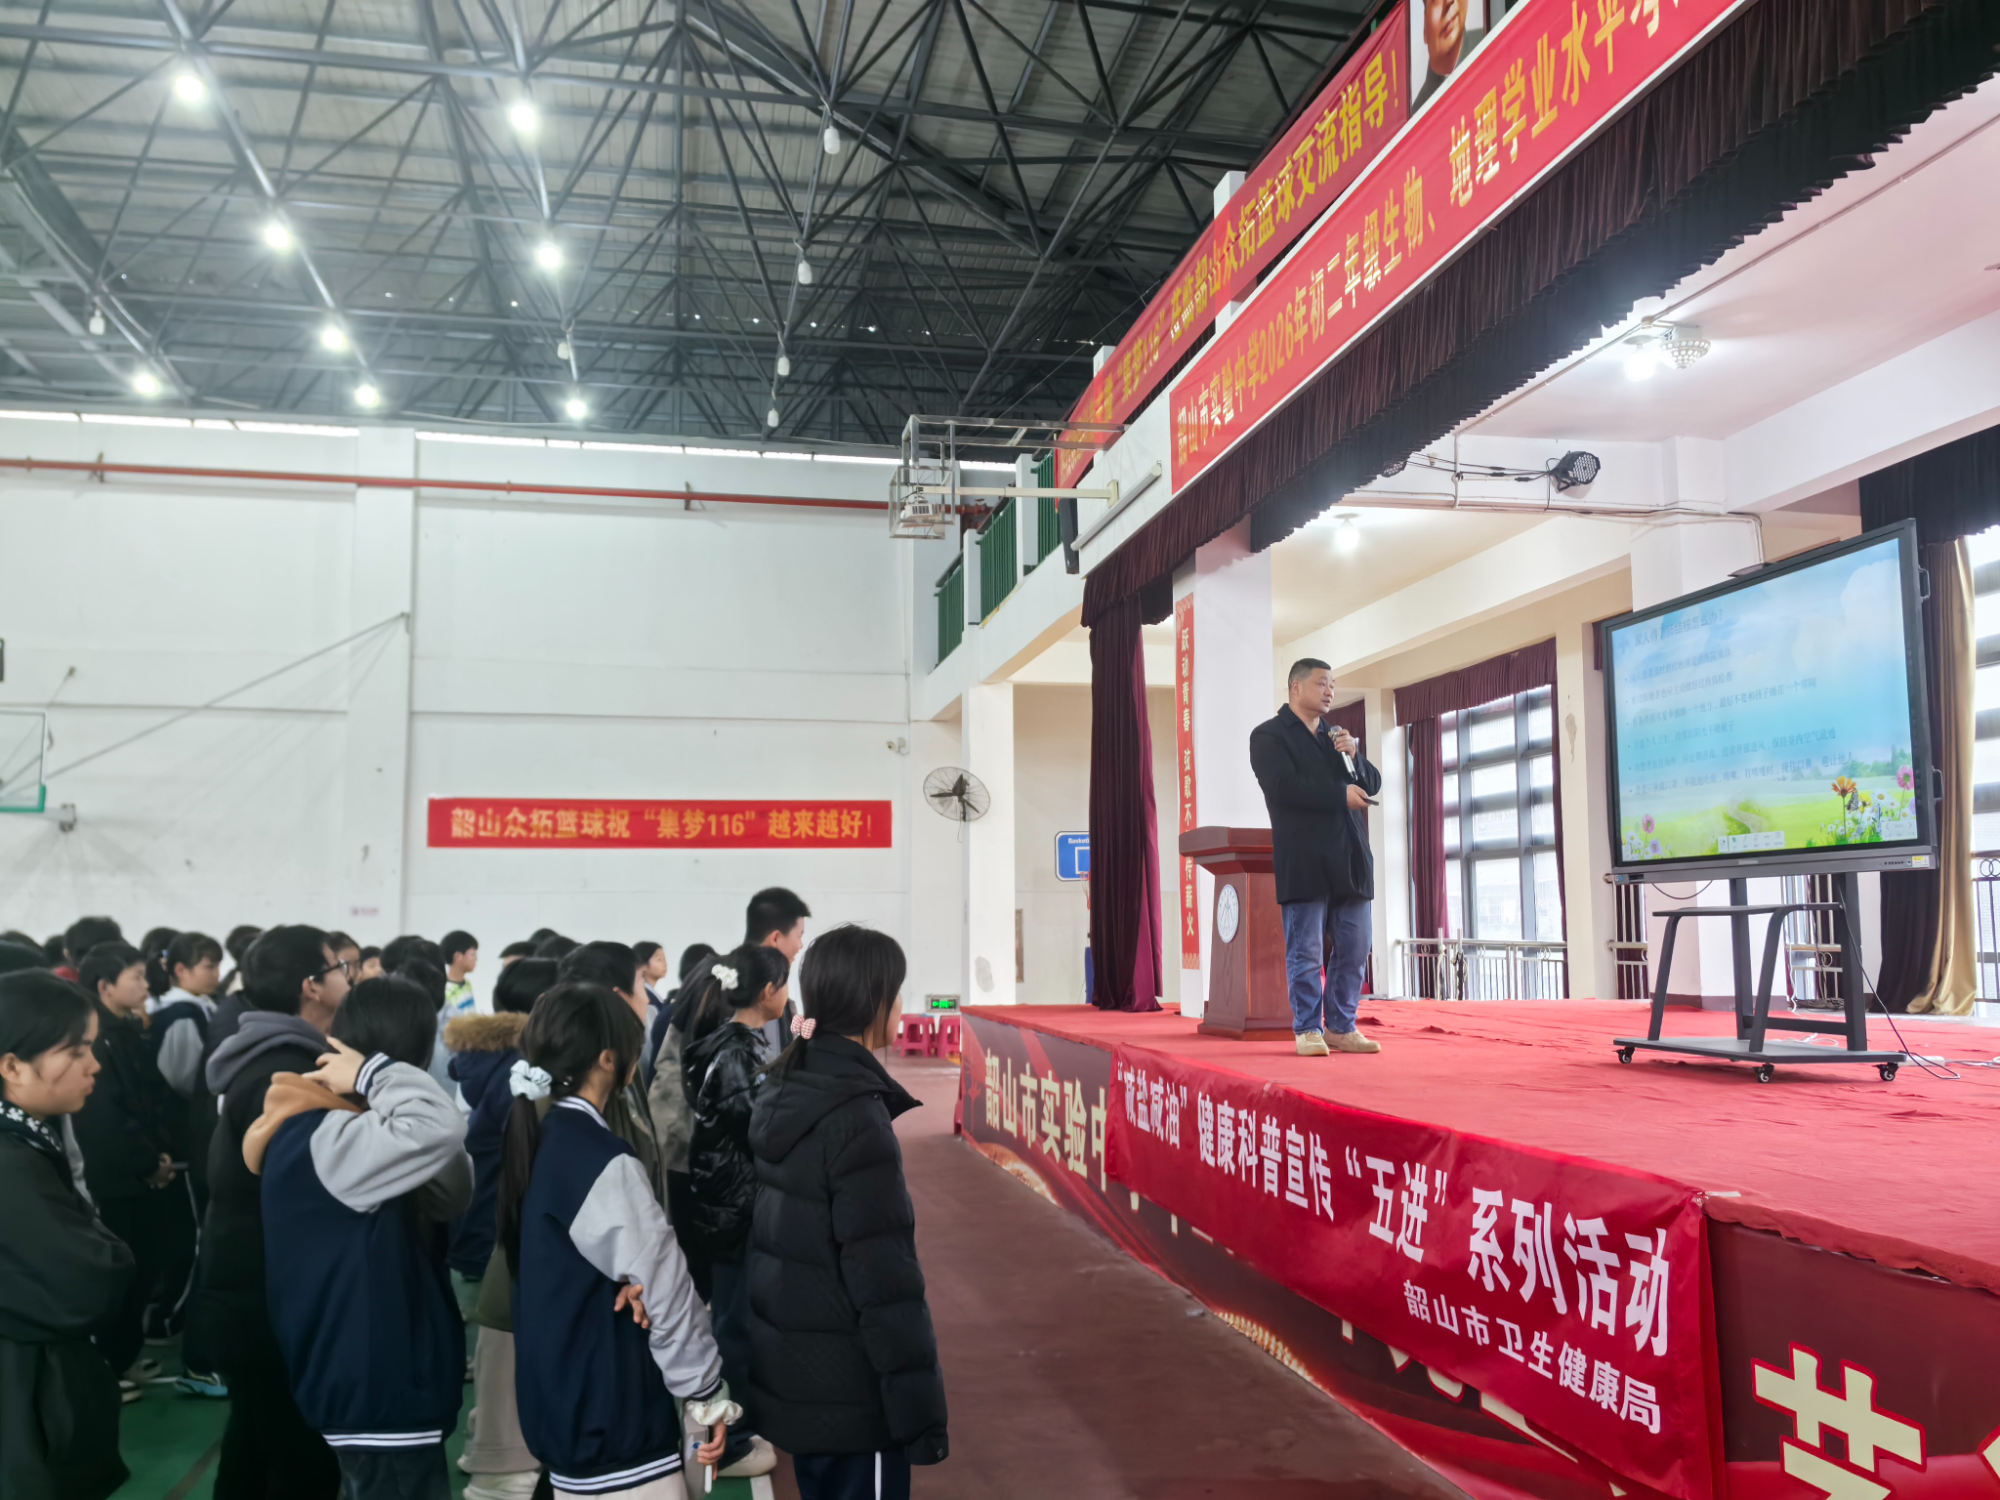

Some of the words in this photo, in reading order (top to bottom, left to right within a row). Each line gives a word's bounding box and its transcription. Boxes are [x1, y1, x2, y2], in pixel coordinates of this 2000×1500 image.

[1177, 0, 1679, 468] 韶山市实验中学2026年初二年级生物、地理学业水平
[1403, 1279, 1661, 1434] 韶山市卫生健康局
